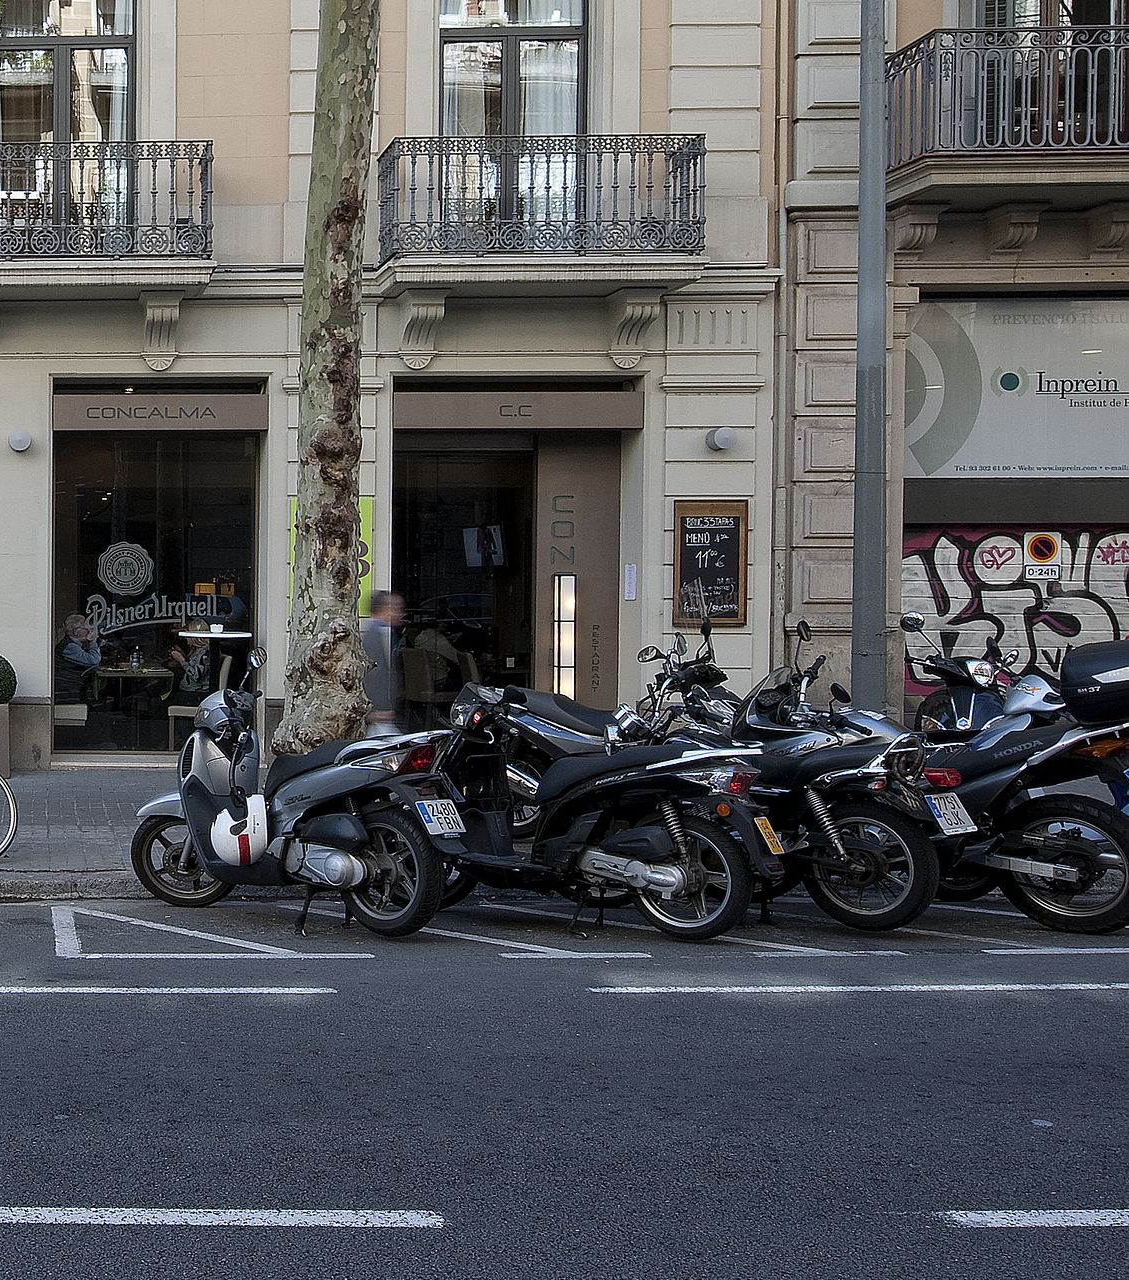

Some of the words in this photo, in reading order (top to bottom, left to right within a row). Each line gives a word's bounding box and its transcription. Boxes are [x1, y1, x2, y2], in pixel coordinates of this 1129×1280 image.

[1036, 371, 1120, 399] Inprein
[1070, 399, 1107, 408] Institut
[1110, 398, 1121, 408] de
[86, 407, 216, 419] CONCALMA
[499, 405, 532, 417] C.C
[86, 594, 153, 640] Pilsner
[150, 592, 217, 627] Urquell
[592, 625, 600, 692] RESTAURANT
[993, 740, 1044, 759] HONDA
[427, 802, 456, 817] 2480
[436, 816, 462, 830] FBN
[942, 810, 966, 826] GJK
